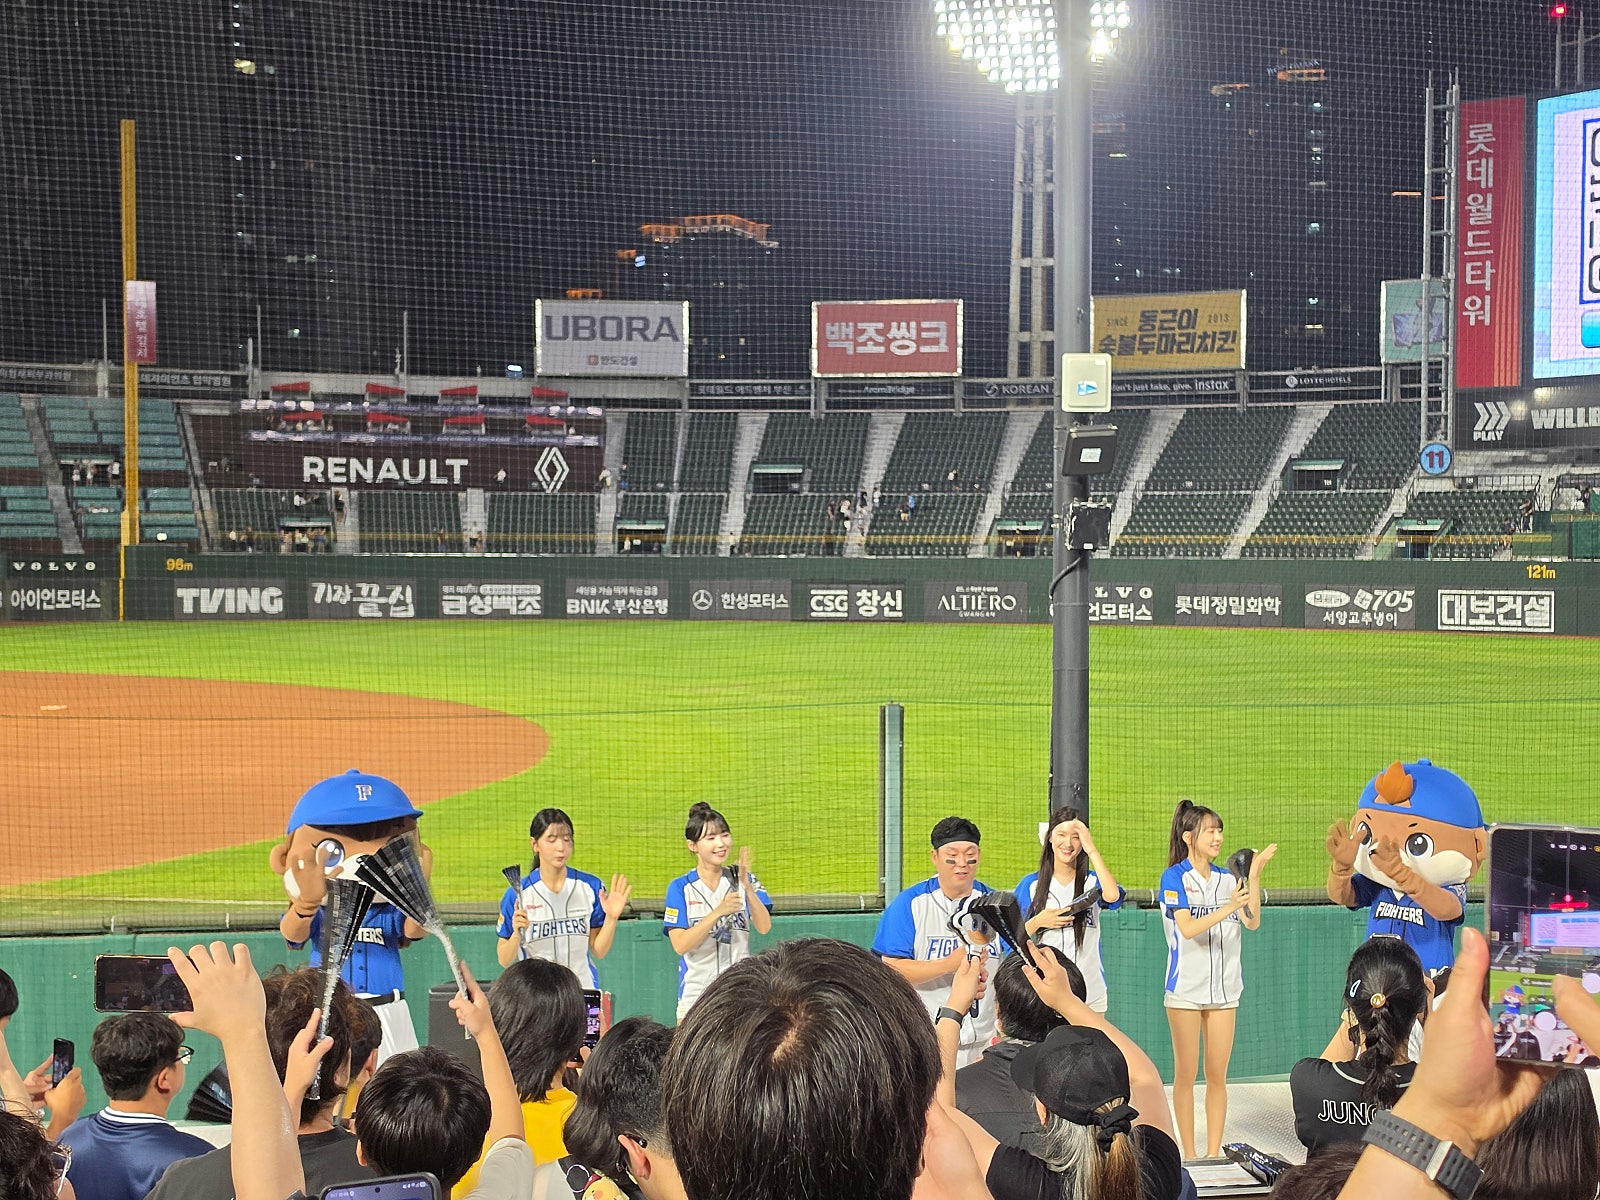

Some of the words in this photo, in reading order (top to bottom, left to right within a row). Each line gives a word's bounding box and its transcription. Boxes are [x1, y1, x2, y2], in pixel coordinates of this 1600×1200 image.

[1462, 123, 1497, 328] 롯데월드타워
[544, 315, 680, 342] UBORA
[1106, 317, 1129, 327] SINCE
[825, 321, 949, 356] 백조씽크
[1002, 384, 1049, 394] KOREAN
[1133, 383, 1148, 393] just
[1195, 378, 1229, 391] instax
[1300, 377, 1324, 385] LOTTE
[1325, 376, 1351, 384] HOTELS
[1473, 430, 1504, 441] PLAY
[1425, 451, 1444, 468] 11
[303, 456, 468, 484] RENAULT
[13, 562, 96, 571] VOLVO
[166, 558, 193, 571] 96m
[1526, 564, 1556, 579] 121m
[10, 588, 101, 611] 아이언모터스
[176, 587, 283, 614] TVING
[720, 592, 789, 610] 한성모터스
[1094, 586, 1153, 599] LVO
[1372, 589, 1416, 613] 705
[442, 595, 541, 615] 금성백조
[566, 598, 610, 615] BNK
[612, 598, 668, 615] 부산은행
[810, 595, 848, 612] CSG
[856, 588, 903, 618] 창신
[1088, 602, 1153, 622] 언모터스
[1175, 595, 1282, 616] 롯데정밀화학
[1441, 594, 1550, 627] 대보건설
[1322, 610, 1398, 627] 서양고추냉이
[355, 784, 373, 801] F
[1375, 901, 1424, 926] FIGHTERS
[355, 927, 385, 946] TERS
[531, 918, 587, 940] FIGHTERS
